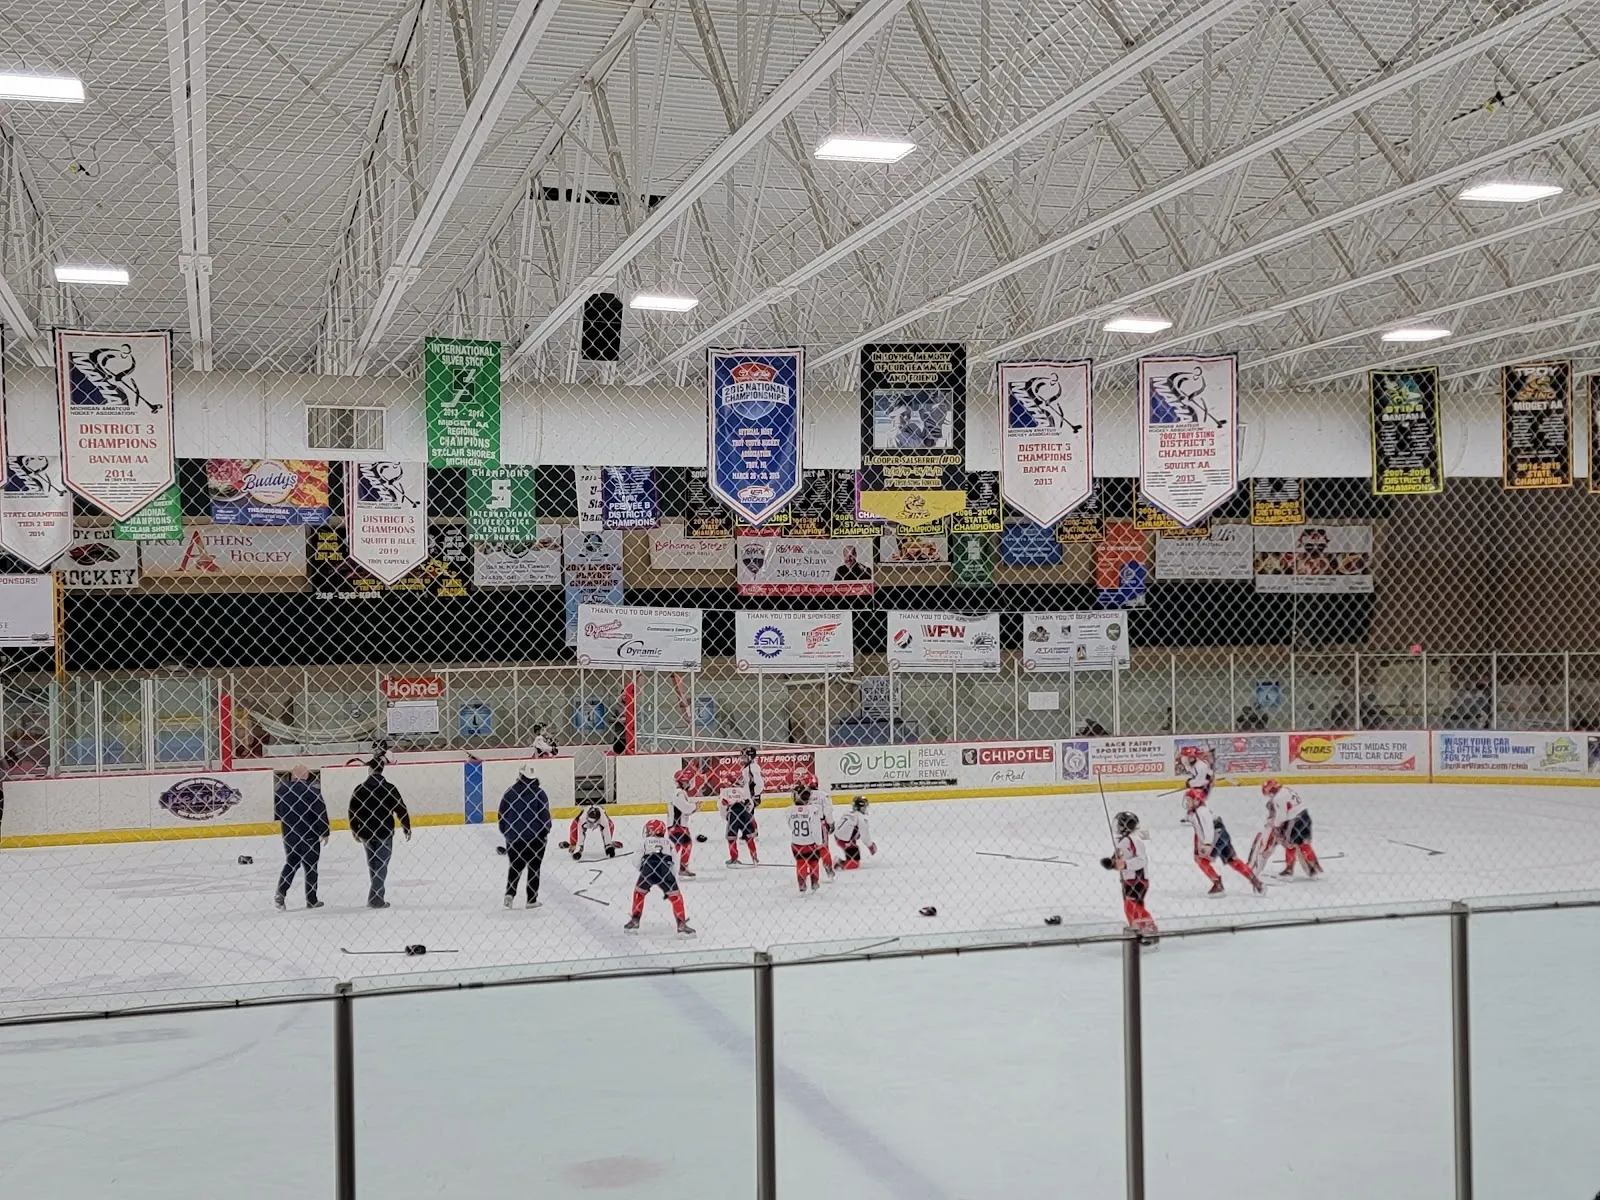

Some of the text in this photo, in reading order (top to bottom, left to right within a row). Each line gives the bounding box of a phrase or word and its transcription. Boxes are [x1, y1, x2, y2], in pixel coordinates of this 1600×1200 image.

[431, 344, 494, 356] INTERNATIONAL
[442, 355, 484, 366] SILVER STICK
[888, 374, 907, 382] AND
[725, 383, 786, 396] 2015 NATIONAL
[724, 391, 786, 402] CHAMPIONSHIPS
[1514, 400, 1563, 410] MIDGET AA
[80, 424, 155, 435] DISTRICT 3
[448, 428, 479, 436] REGIONAL
[79, 438, 157, 449] CHAMPIONS
[440, 437, 490, 448] CHAMPIONS
[1160, 438, 1215, 447] DISTRICT 3
[1018, 443, 1071, 452] DISTRICT 3
[467, 450, 495, 459] SHORES
[1017, 453, 1072, 462] CHAMPIONS
[1159, 449, 1216, 458] CHAMPIONS
[89, 455, 149, 464] BANTAM AA
[872, 456, 899, 465] COOPER
[105, 469, 134, 478] 2014
[243, 472, 297, 490] Buddy's
[363, 515, 414, 523] DISTRICT 3
[608, 511, 645, 519] DISTRICT
[606, 518, 655, 527] CHAMPIONS
[900, 525, 941, 533] CHAMPIONS
[655, 541, 696, 551] Bahama
[230, 550, 292, 563] HOCKEY
[927, 625, 966, 637] VFW
[760, 637, 778, 645] SM
[626, 647, 662, 655] Dynamic
[1444, 738, 1468, 746] WASH
[1470, 738, 1492, 746] YOUR
[1300, 746, 1332, 754] MIDAS
[1337, 743, 1362, 751] TRUST
[1392, 743, 1407, 751] FOR
[1444, 746, 1455, 754] AS
[1457, 746, 1480, 754] OFTEN
[1482, 746, 1493, 754] AS
[1512, 746, 1536, 754] WANT
[867, 750, 911, 769] urbal
[982, 749, 1050, 762] CHIPOTLE
[919, 759, 948, 767] REVIVE.
[1005, 770, 1025, 782] Real
[793, 820, 809, 837] 89
